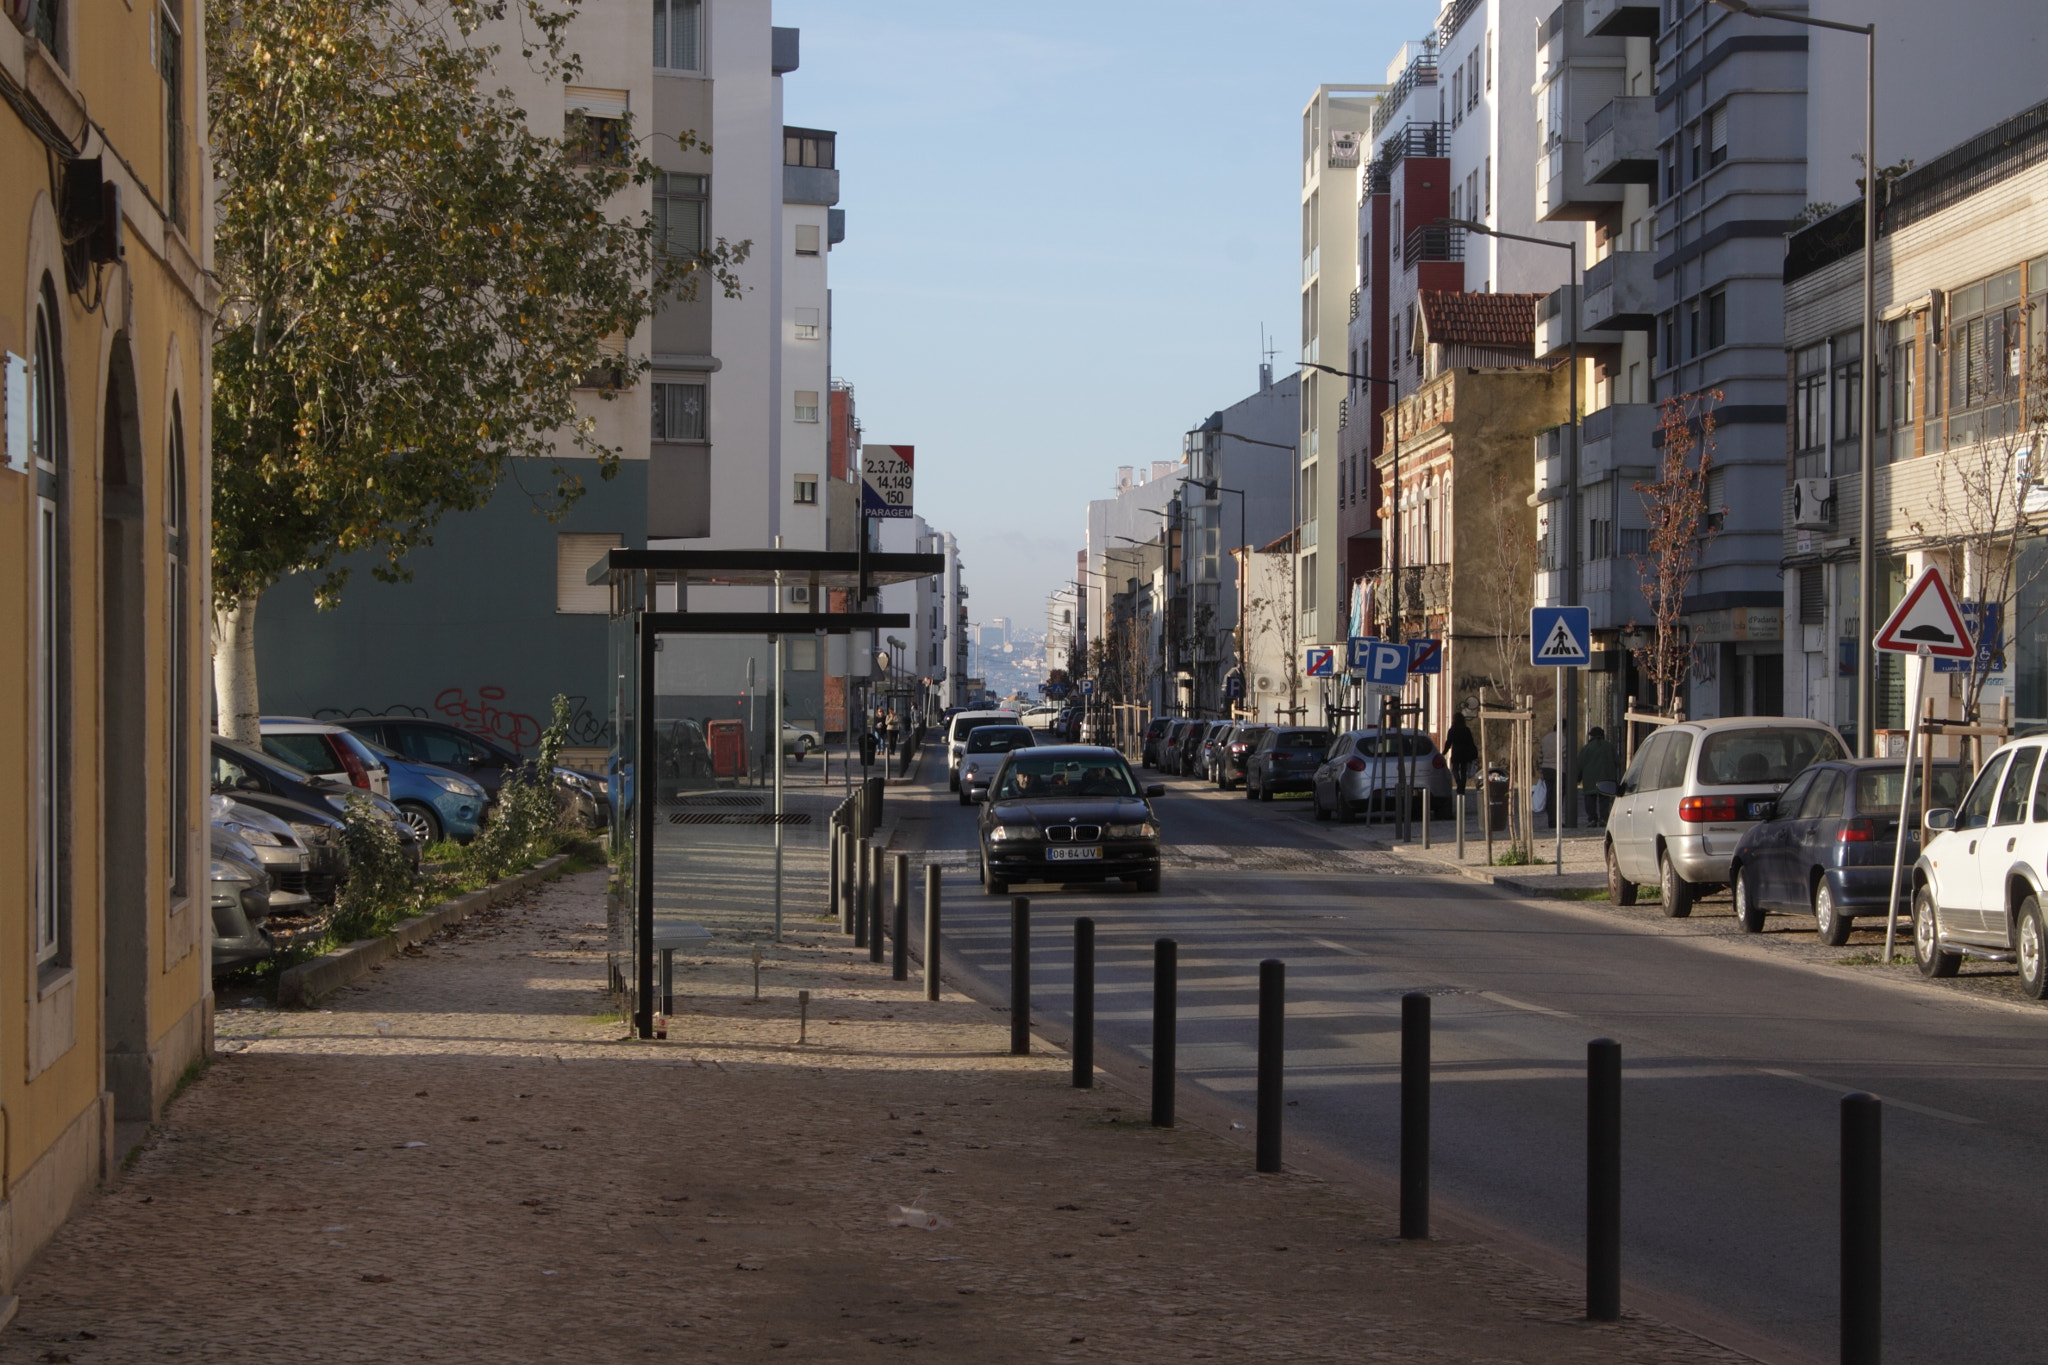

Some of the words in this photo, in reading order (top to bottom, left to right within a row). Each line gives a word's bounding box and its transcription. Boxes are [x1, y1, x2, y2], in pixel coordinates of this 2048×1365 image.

[867, 461, 909, 474] 2.3.7.18
[877, 476, 912, 489] 14.149
[886, 491, 904, 504] 150
[865, 508, 912, 517] PARAGEM
[1355, 639, 1370, 665] P
[1312, 651, 1327, 674] P
[1374, 647, 1401, 680] P
[1082, 681, 1091, 693] P
